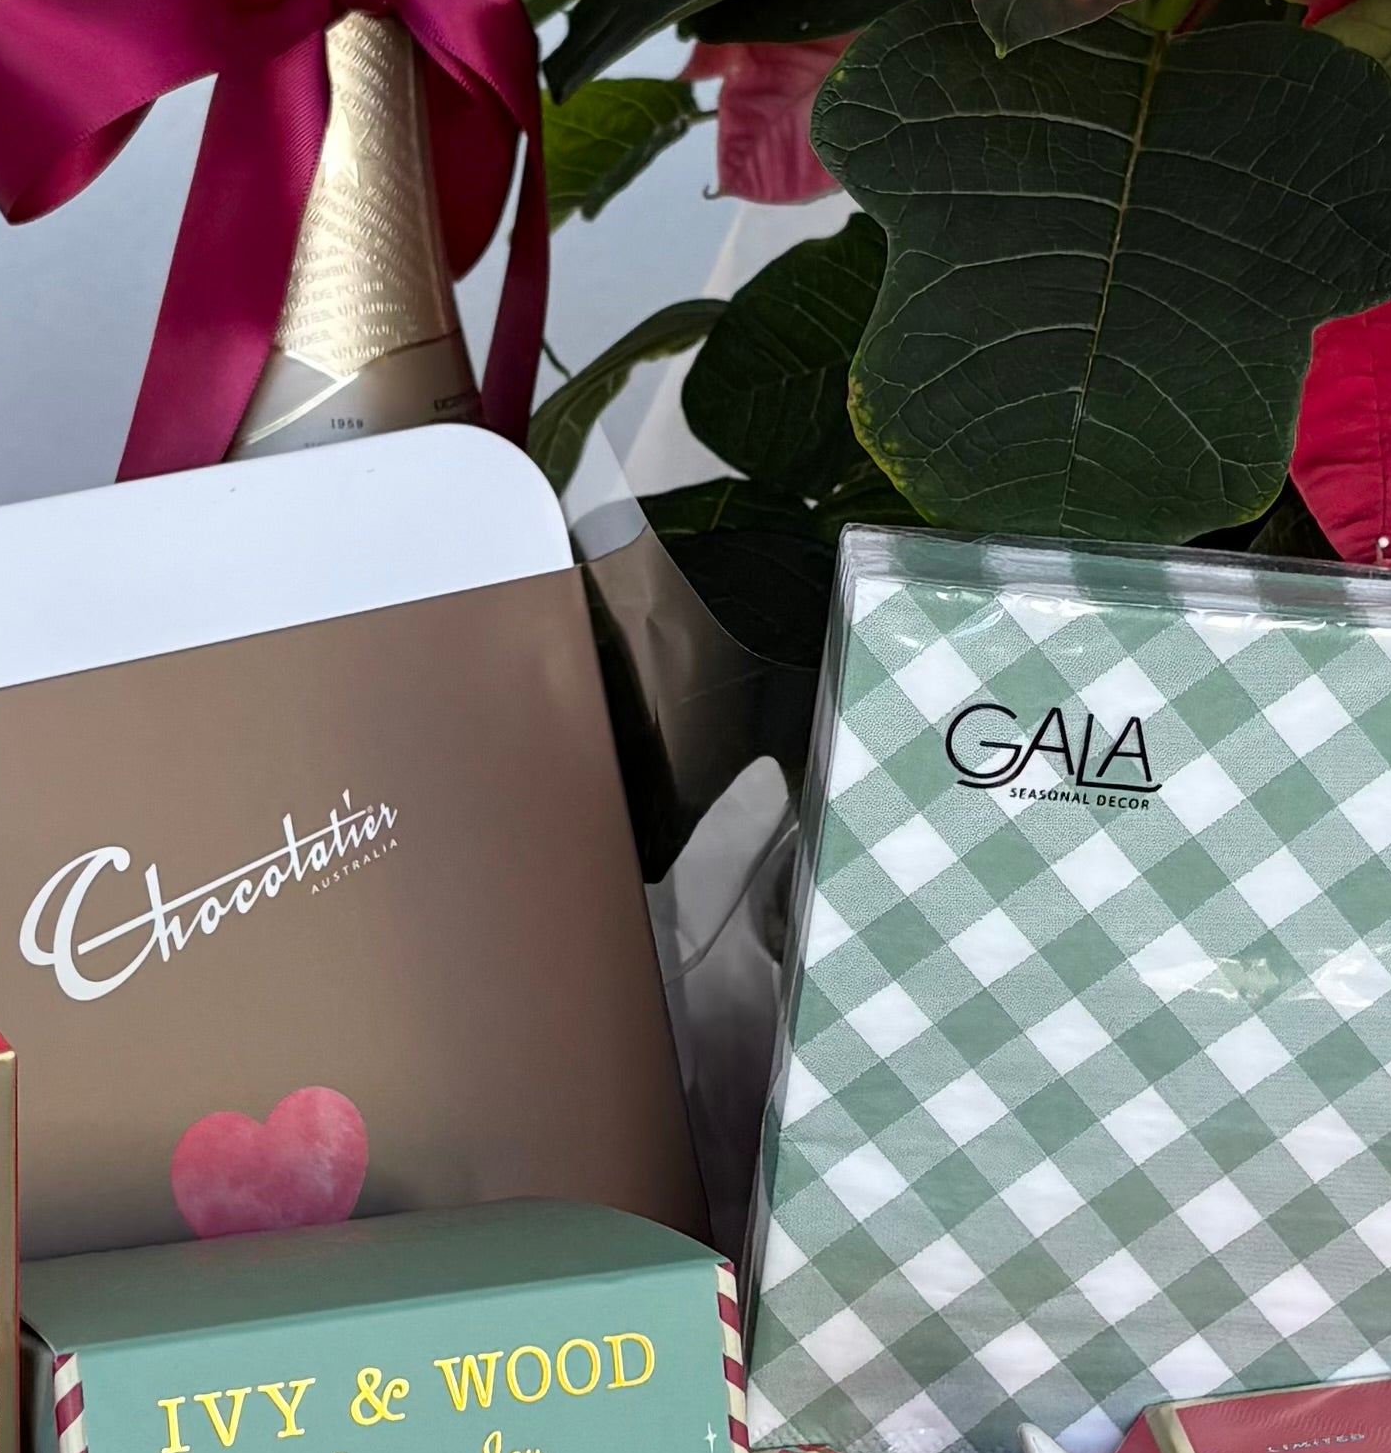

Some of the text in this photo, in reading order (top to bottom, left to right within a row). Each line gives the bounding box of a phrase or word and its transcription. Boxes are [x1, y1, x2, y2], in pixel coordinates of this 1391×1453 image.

[945, 703, 1163, 793] GALA
[1009, 787, 1150, 811] SEASONAL DECOR
[18, 788, 399, 1002] Chocolatier
[310, 838, 399, 895] AUSTRALIA
[349, 1367, 410, 1426] &
[433, 1332, 657, 1412] WOOD
